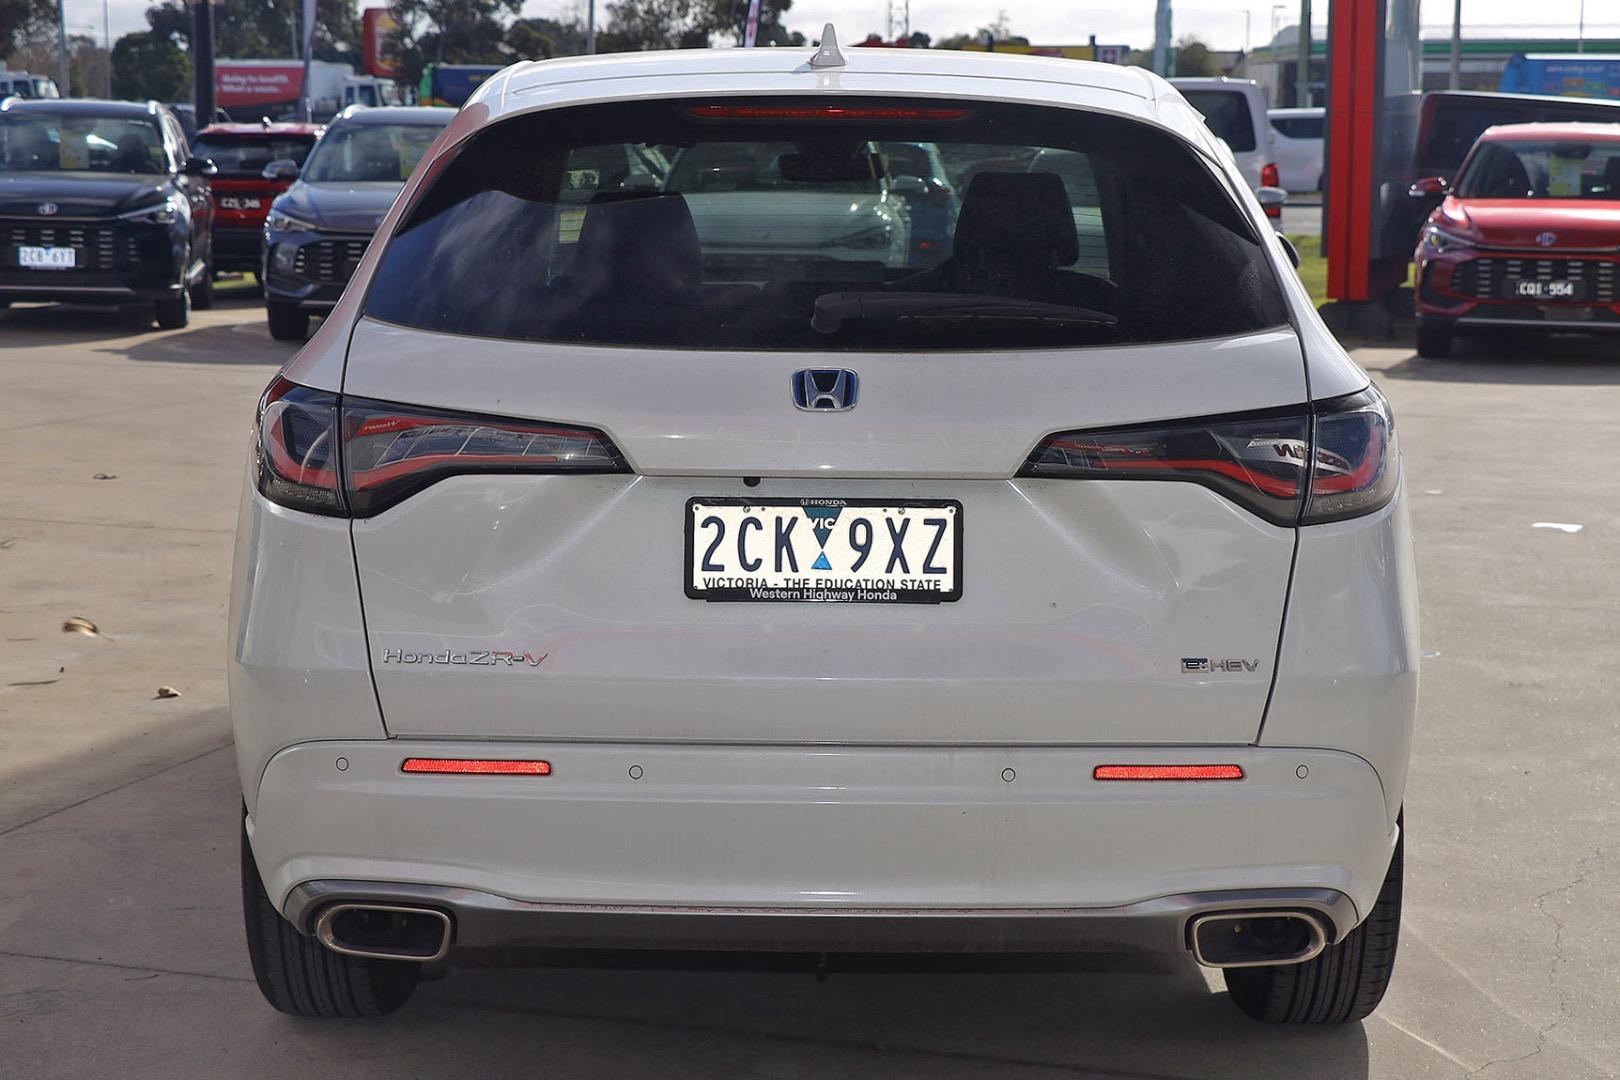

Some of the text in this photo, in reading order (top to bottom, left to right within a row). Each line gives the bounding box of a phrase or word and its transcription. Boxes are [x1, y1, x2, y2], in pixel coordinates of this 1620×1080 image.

[811, 499, 847, 507] HONDA
[808, 517, 836, 530] VIC
[701, 515, 948, 575] 2CK 9XZ
[702, 577, 768, 590] VICTORIA
[784, 577, 810, 590] THE
[815, 578, 896, 591] EDUCATION
[900, 578, 942, 591] STATE
[749, 588, 898, 602] Western Highway Honda
